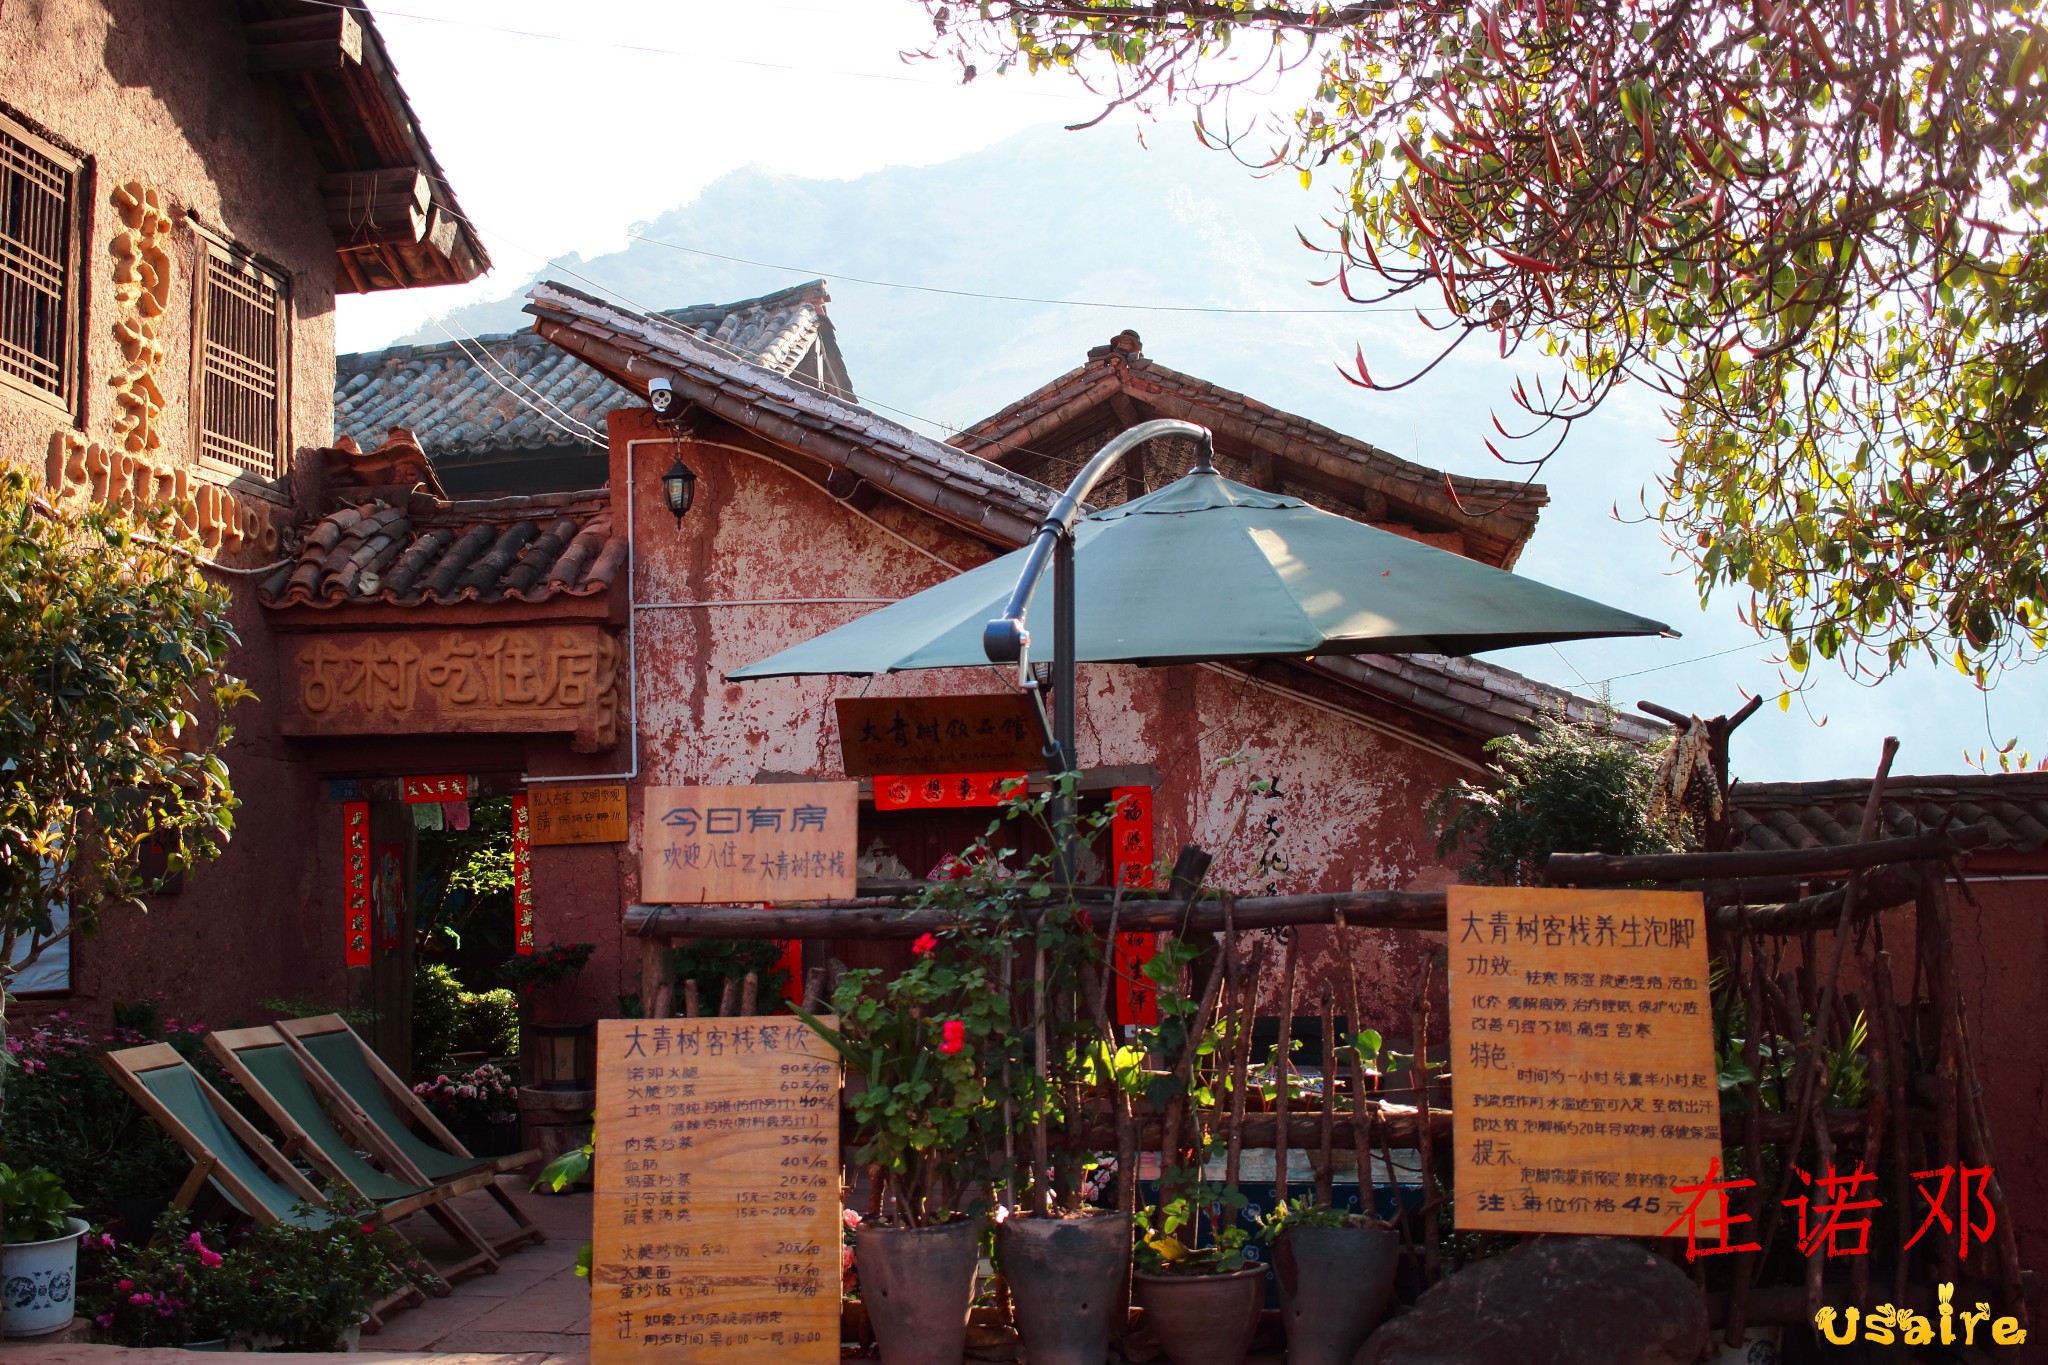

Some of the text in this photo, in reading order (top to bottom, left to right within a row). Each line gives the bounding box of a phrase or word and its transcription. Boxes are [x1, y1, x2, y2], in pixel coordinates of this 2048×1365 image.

[300, 632, 594, 712] 古村吃住店
[660, 804, 827, 837] 今日有房
[663, 841, 737, 871] 欢迎入住
[759, 851, 845, 881] 大青树客栈
[1460, 910, 1695, 949] 大青树客栈养生泡脚
[624, 1025, 810, 1059] 大青树客栈餐饮
